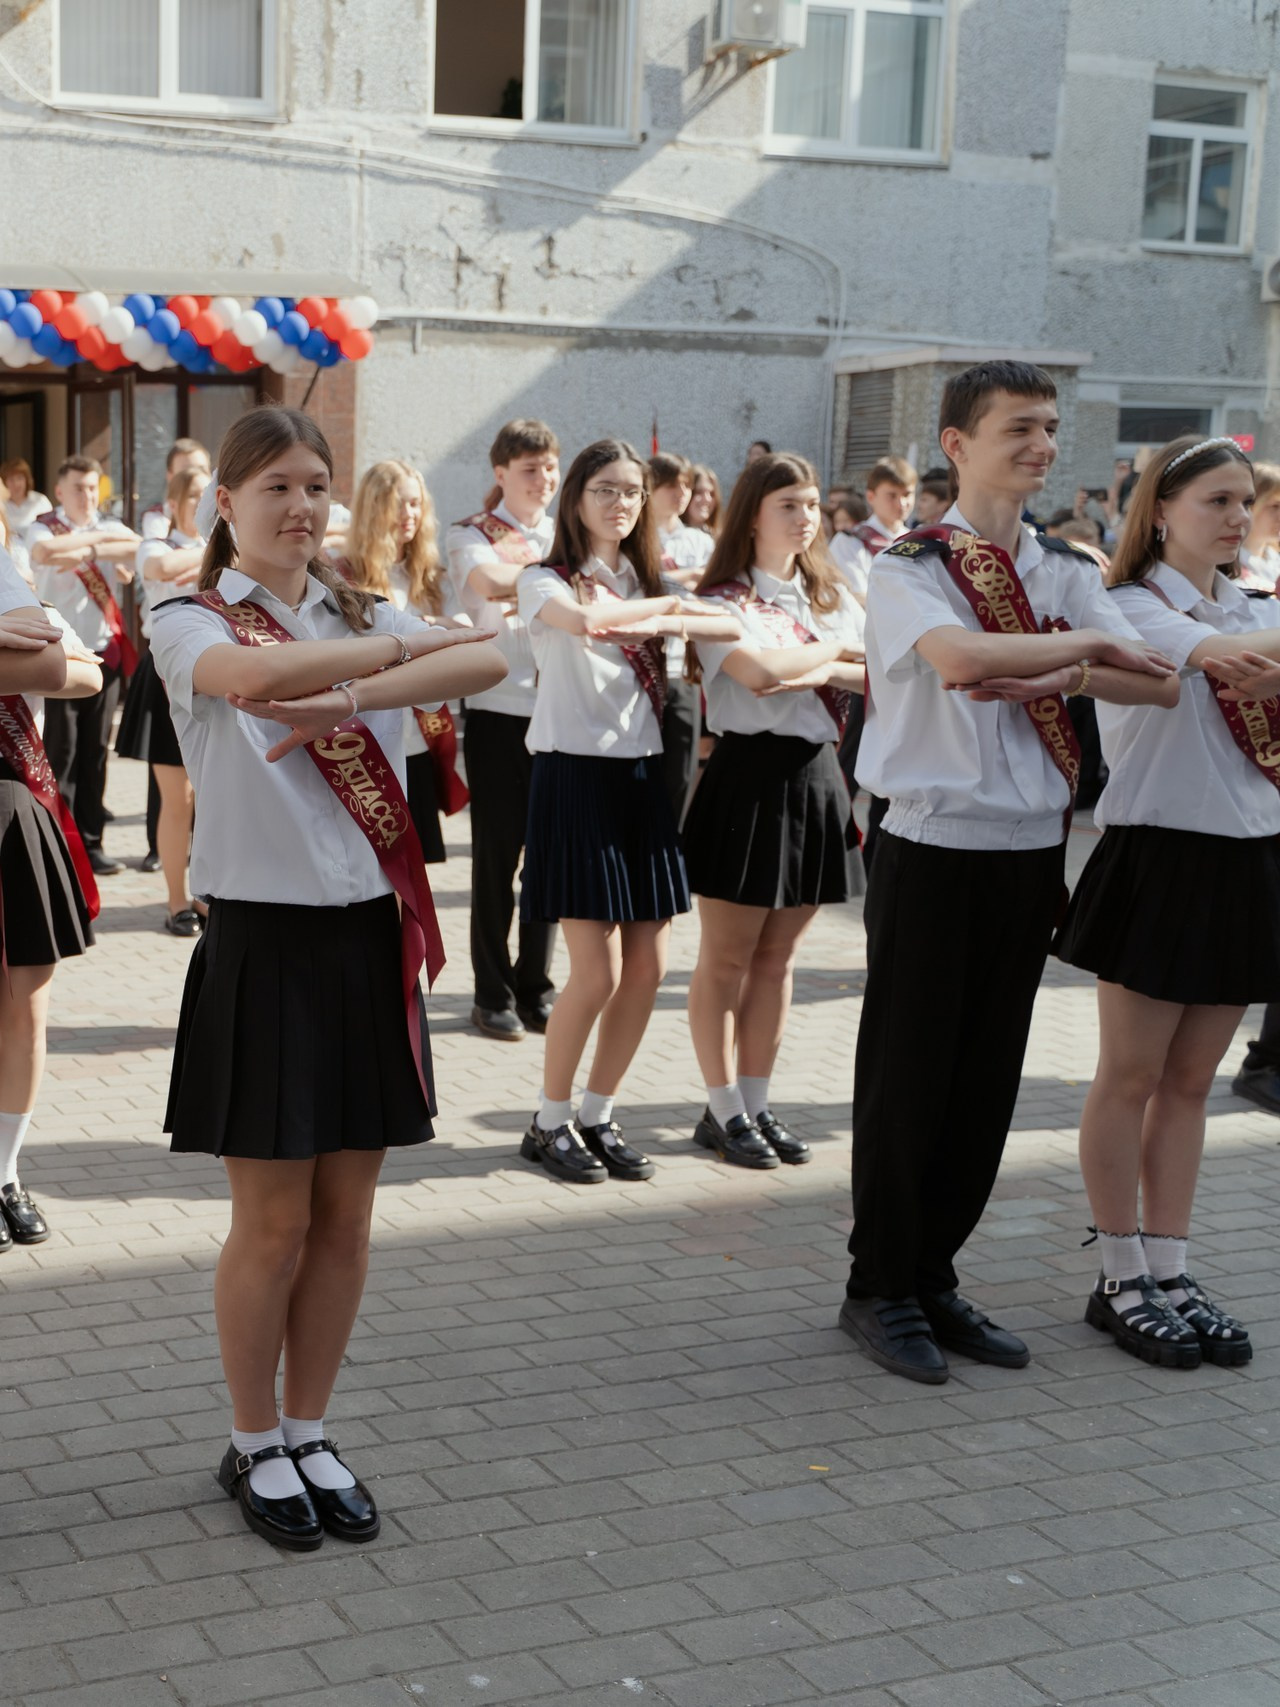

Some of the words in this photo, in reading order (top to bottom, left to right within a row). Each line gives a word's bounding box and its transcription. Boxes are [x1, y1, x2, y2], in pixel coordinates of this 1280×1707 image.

[1029, 698, 1060, 722] 9
[314, 732, 366, 760] 9
[337, 757, 400, 849] КЛАССА
